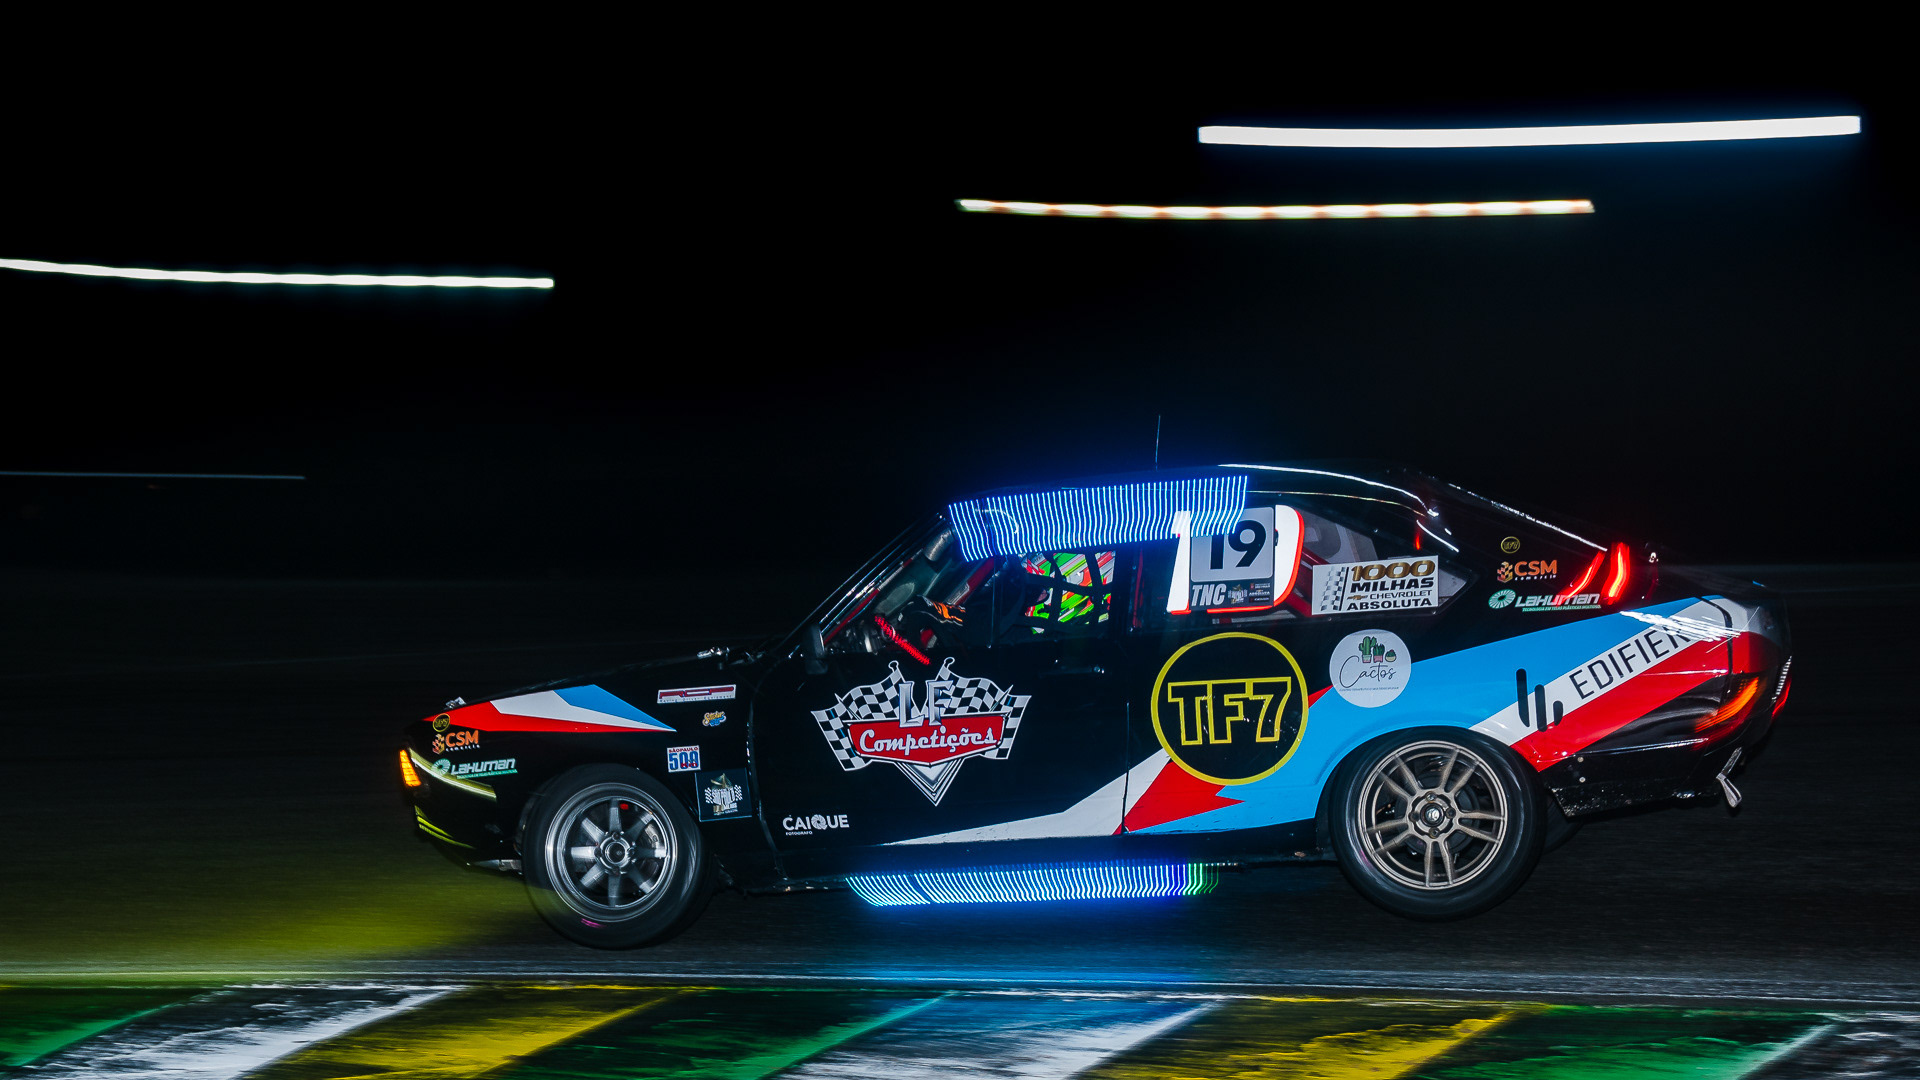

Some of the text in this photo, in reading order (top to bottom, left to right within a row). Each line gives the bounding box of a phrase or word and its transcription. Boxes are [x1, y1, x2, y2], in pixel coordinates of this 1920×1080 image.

[1206, 519, 1267, 570] 19
[1351, 560, 1436, 582] 1000
[1514, 560, 1558, 577] CSM
[1191, 583, 1227, 607] TNC
[1350, 577, 1435, 594] MILHAS
[1369, 590, 1433, 600] CHEVROLET
[1346, 598, 1433, 612] ABSOLUTA
[1339, 655, 1397, 688] Cactos
[899, 680, 953, 728] LF
[1168, 676, 1292, 746] TF7
[445, 730, 479, 748] CSM
[859, 725, 998, 756] Competições
[668, 750, 700, 771] 500
[782, 814, 850, 831] CAIQUE
